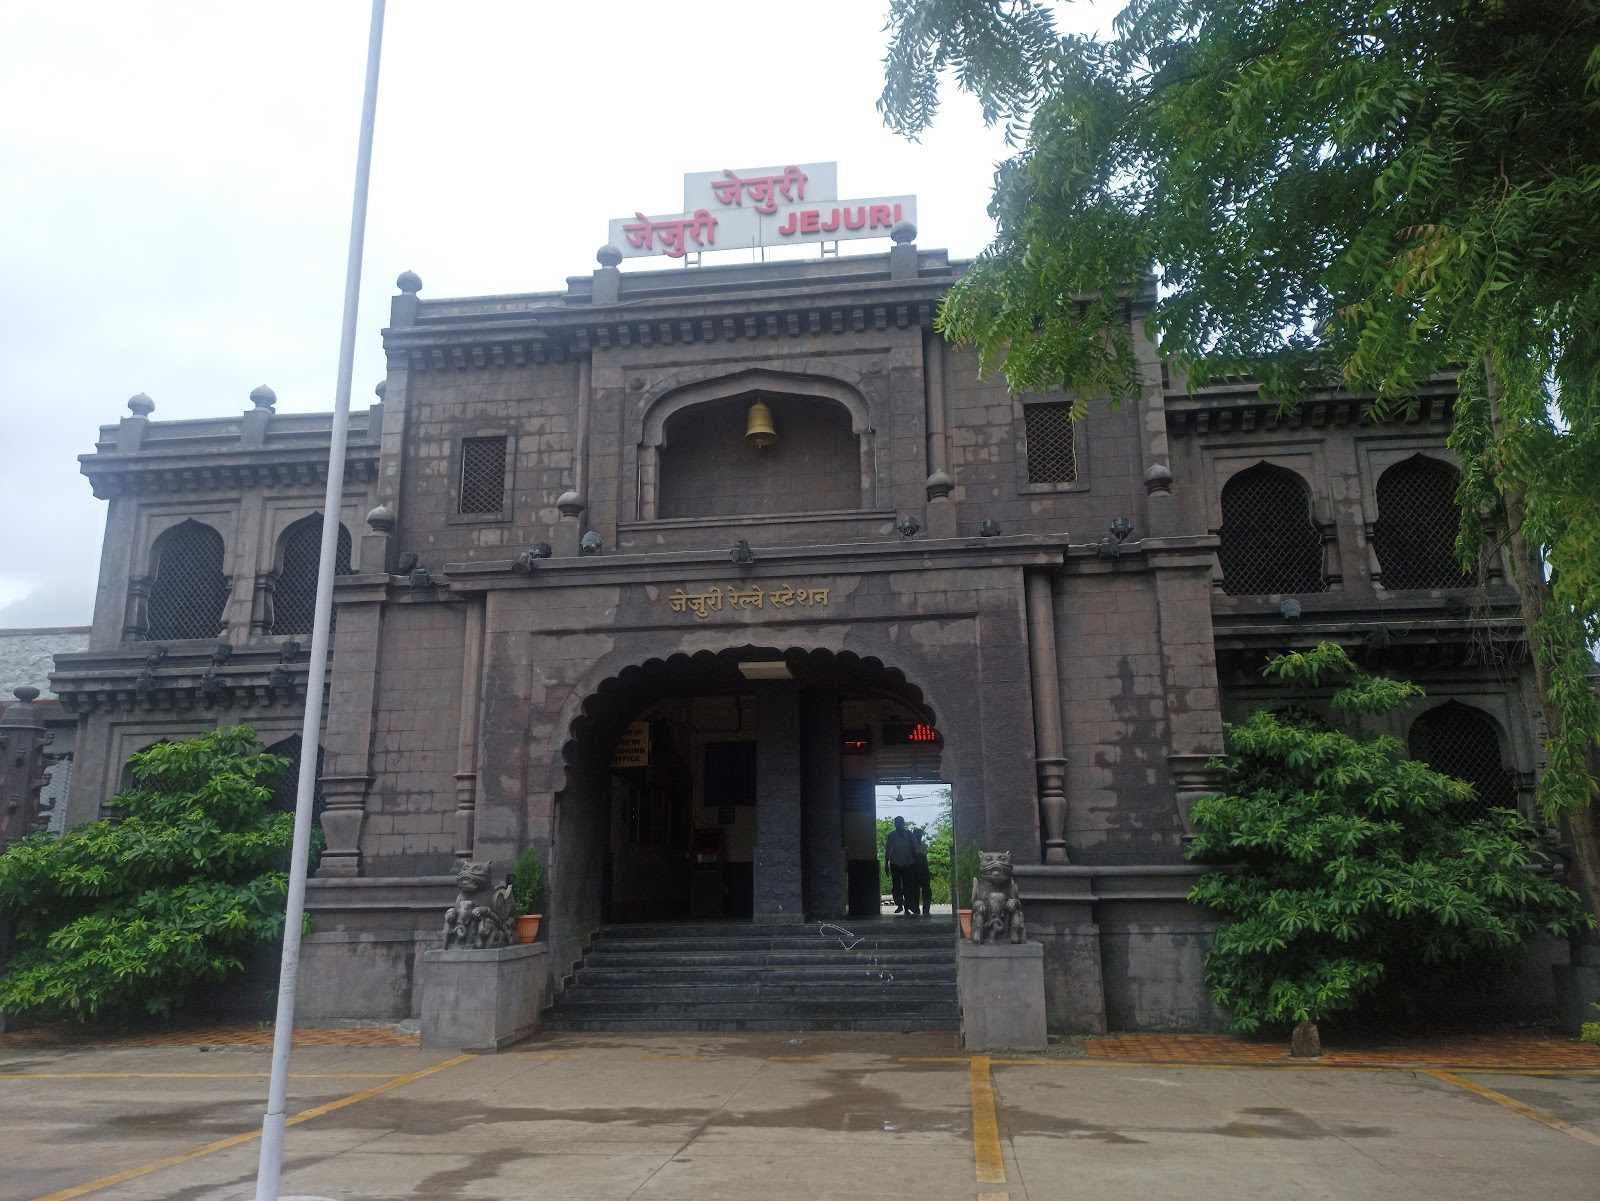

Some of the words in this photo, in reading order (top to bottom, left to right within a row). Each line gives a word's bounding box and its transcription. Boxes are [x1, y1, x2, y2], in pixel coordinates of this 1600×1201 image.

[711, 165, 808, 215] जेजुरी
[622, 209, 718, 258] जेजुरी
[778, 204, 903, 236] JEJURI
[668, 586, 723, 618] जेजुरी
[727, 585, 764, 609] रेल्वे
[769, 583, 830, 609] स्टेशन
